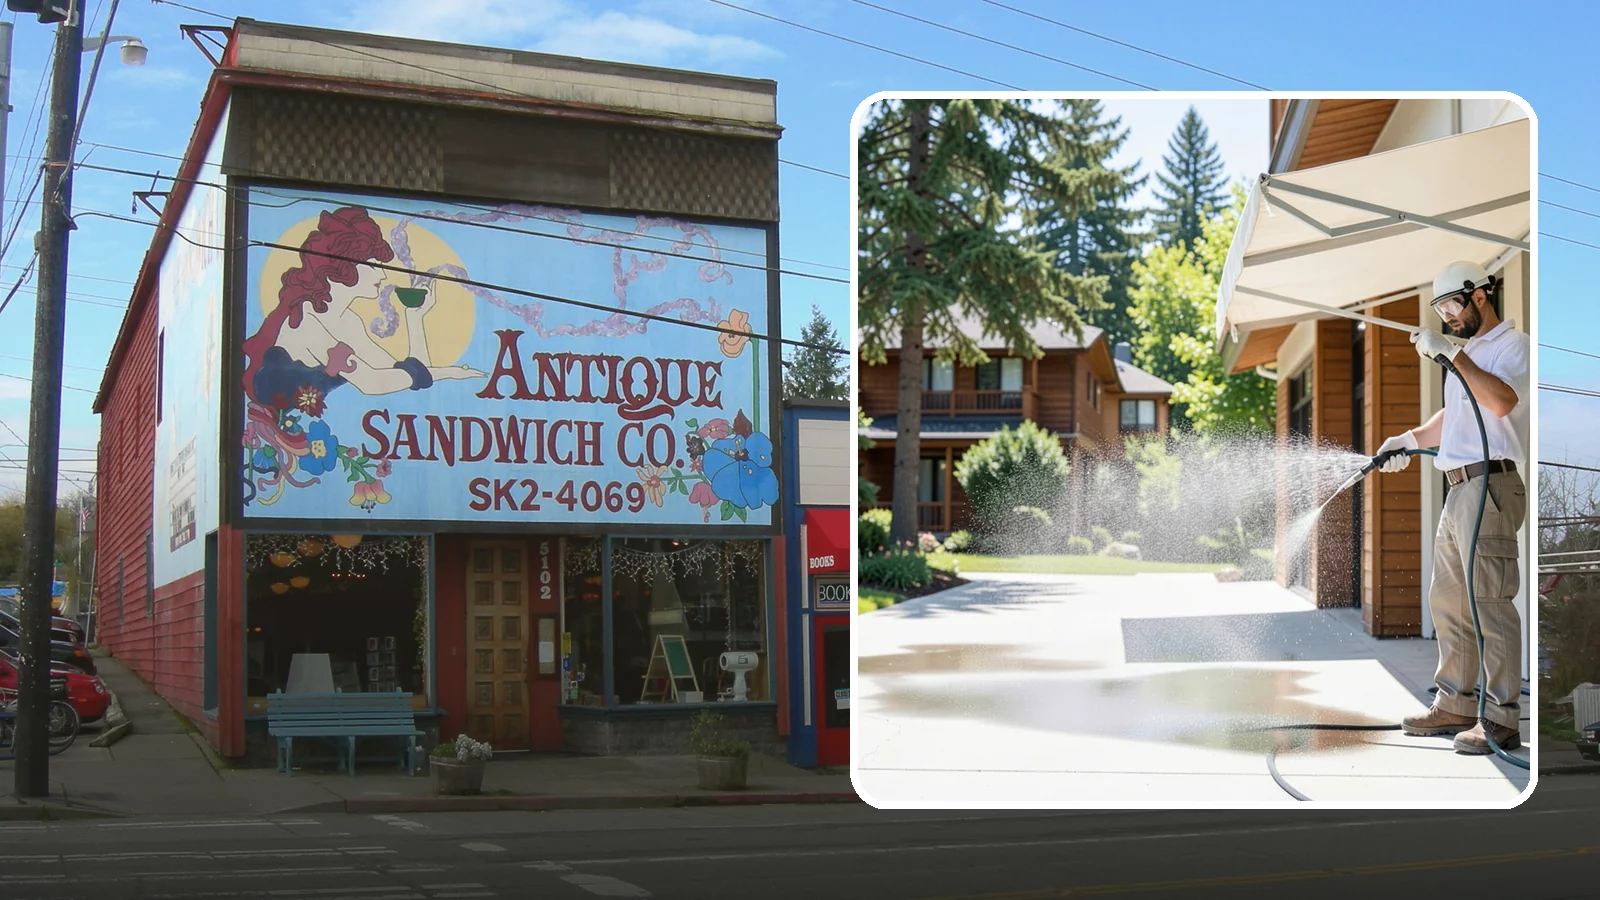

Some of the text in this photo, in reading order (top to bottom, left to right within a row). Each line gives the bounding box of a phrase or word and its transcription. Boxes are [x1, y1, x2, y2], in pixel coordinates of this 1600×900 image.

[476, 330, 724, 421] ANTIQUE
[361, 409, 685, 469] SANDWICH CO.
[469, 478, 646, 513] SK2-4069
[540, 541, 551, 600] 5102
[809, 555, 835, 569] BOOKS
